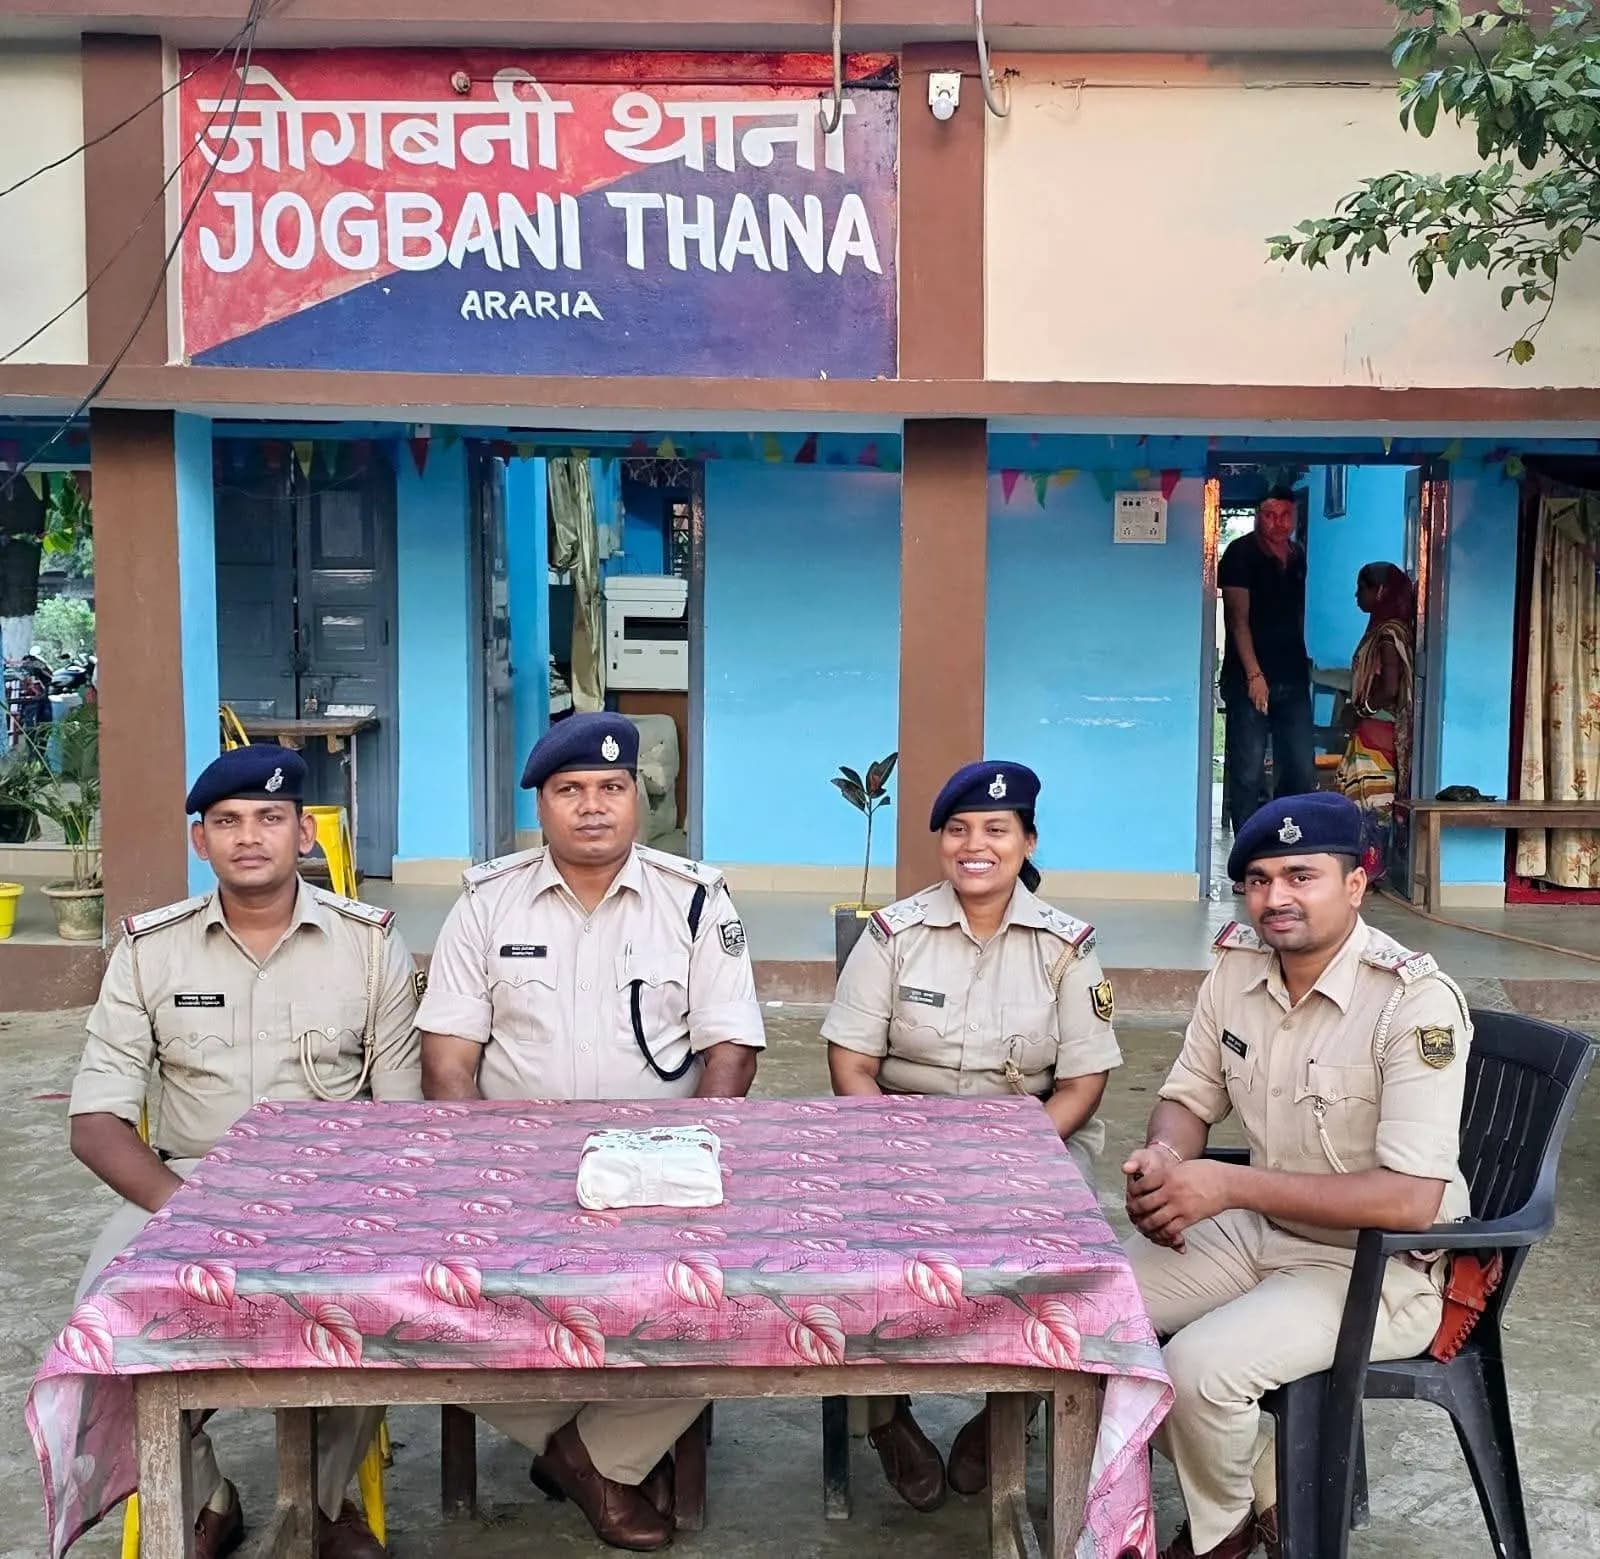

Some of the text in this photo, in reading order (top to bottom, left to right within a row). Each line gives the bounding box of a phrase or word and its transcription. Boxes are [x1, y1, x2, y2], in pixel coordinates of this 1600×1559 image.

[195, 65, 856, 173] जोगबनी थाना
[200, 191, 883, 275] JOGBANI THANA
[460, 289, 605, 321] ARARIA
